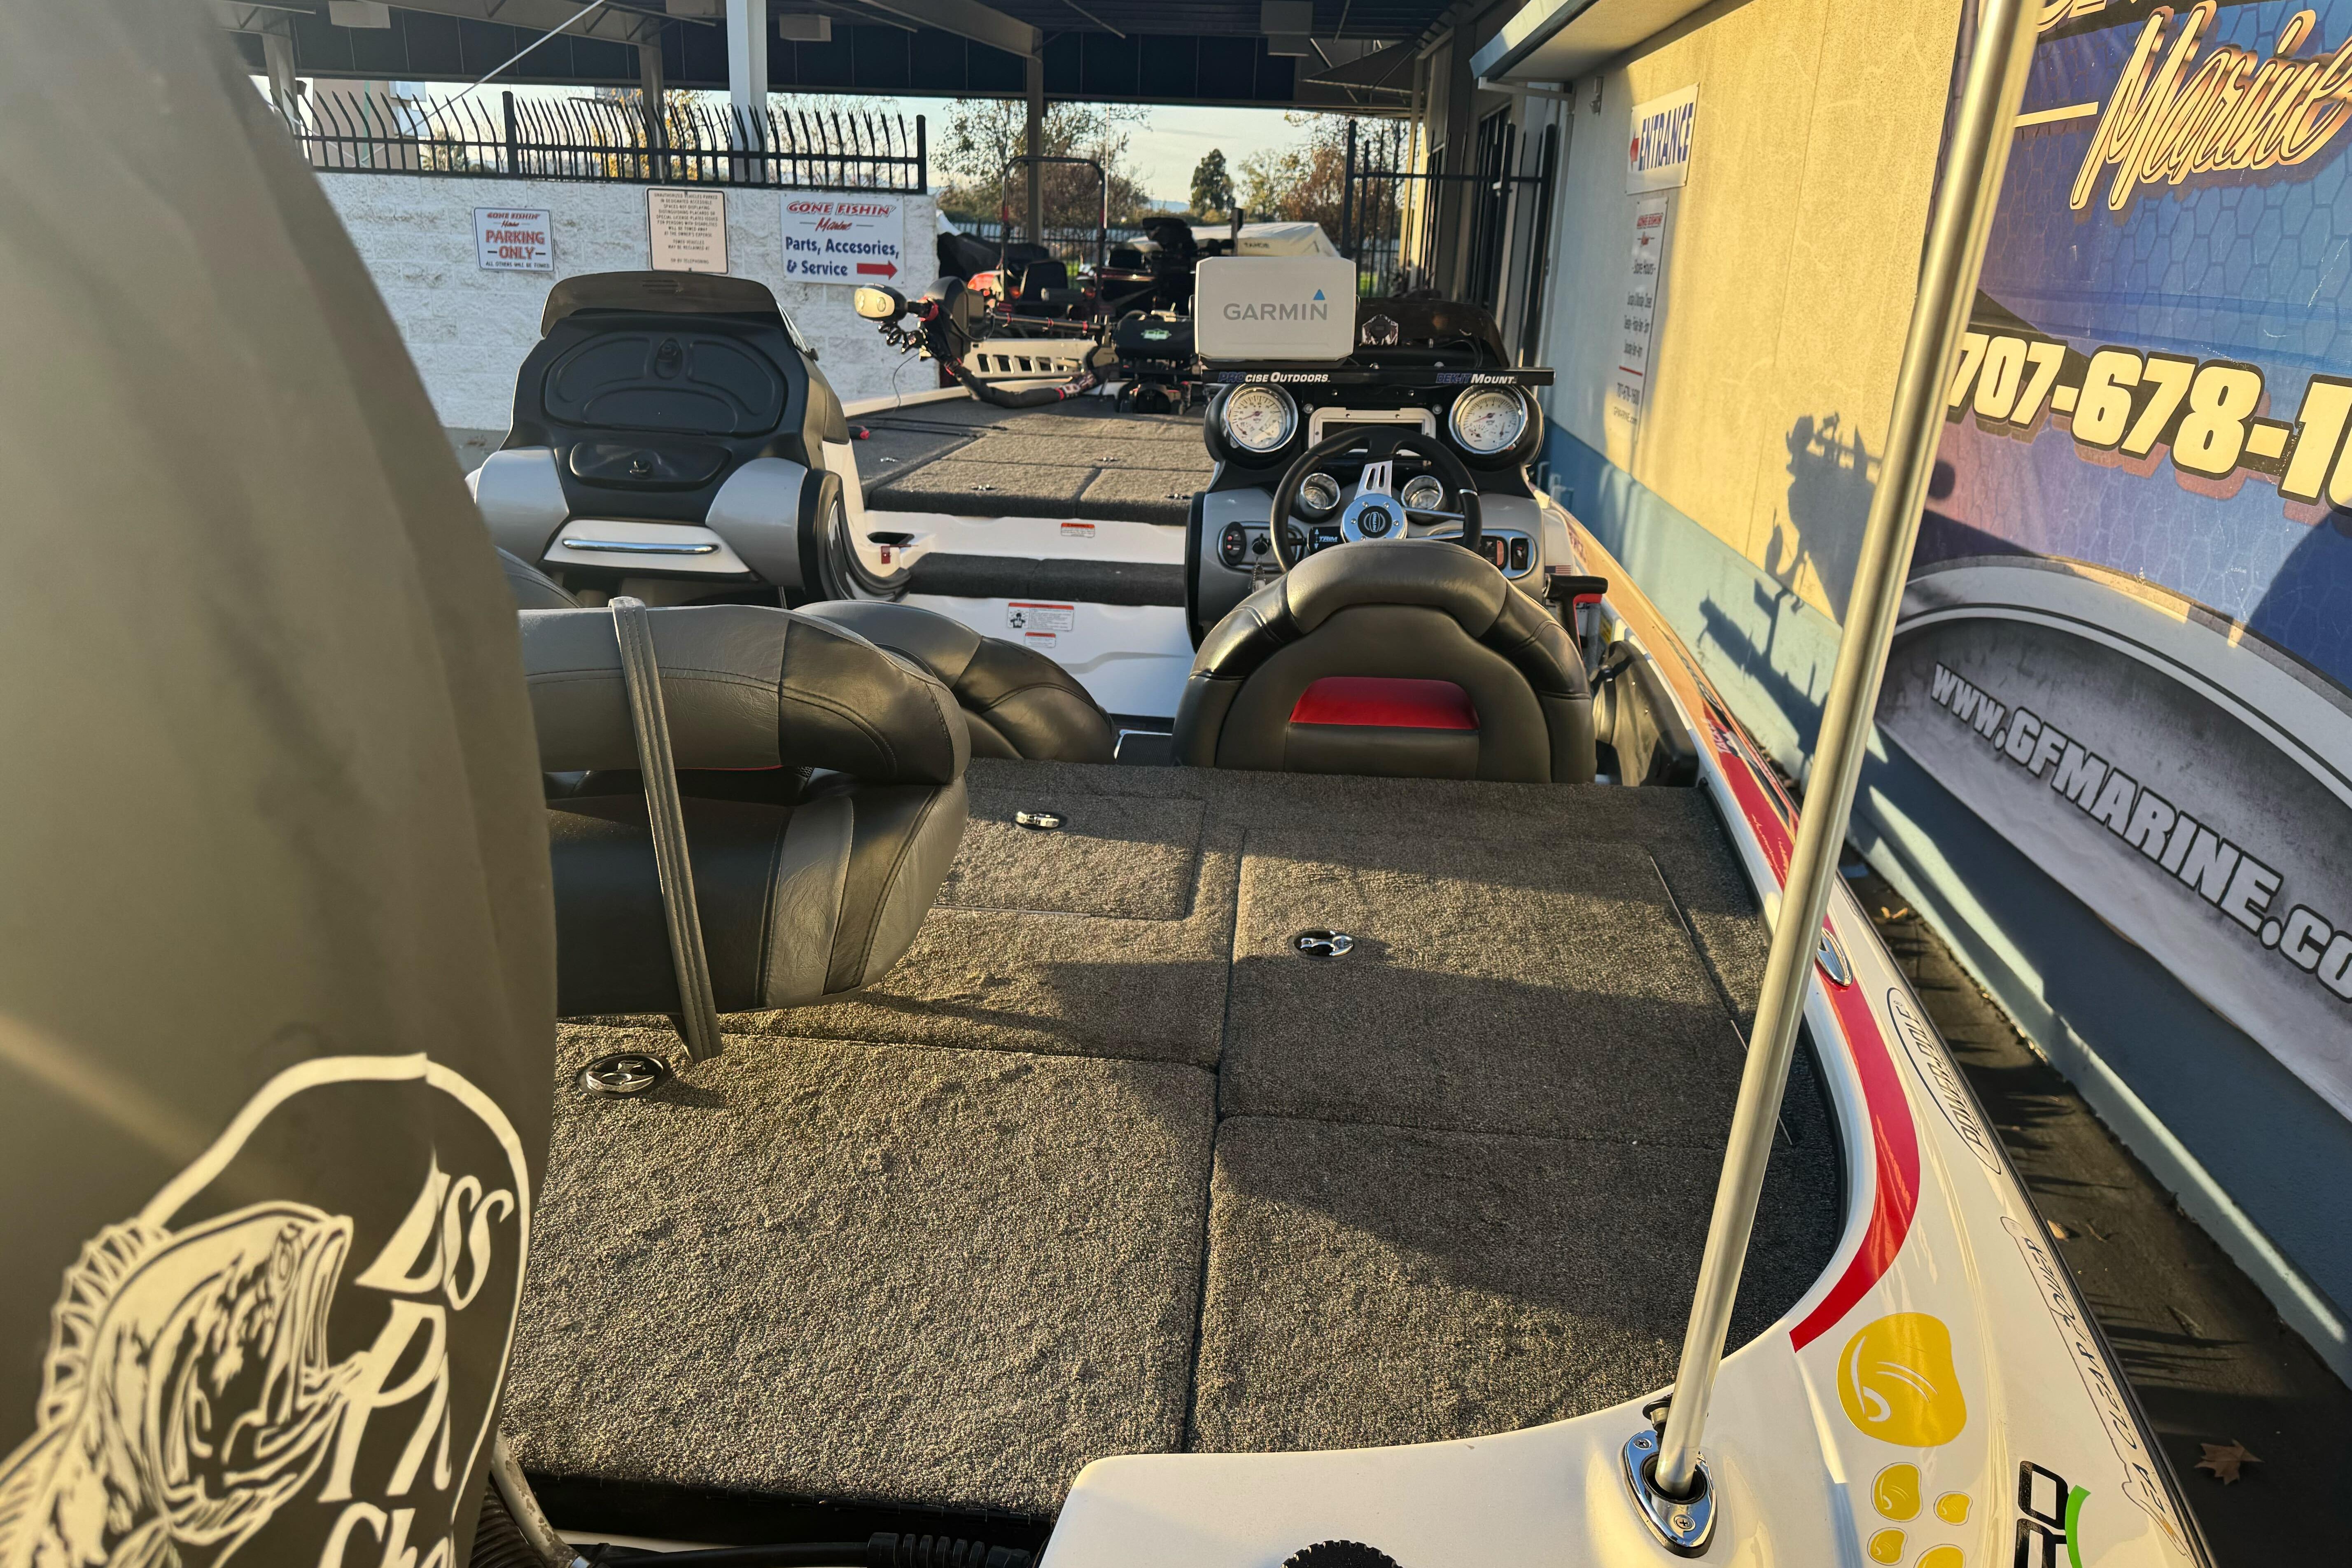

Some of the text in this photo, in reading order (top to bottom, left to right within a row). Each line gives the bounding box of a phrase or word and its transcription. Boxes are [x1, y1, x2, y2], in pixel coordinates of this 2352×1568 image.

[1638, 102, 1694, 171] ENTRANCE
[787, 201, 834, 215] GONE
[485, 230, 545, 245] PARKING
[499, 245, 536, 259] ONLY
[786, 236, 899, 259] Parts, Accesories,
[801, 260, 848, 276] Service
[1223, 303, 1328, 321] GARMIN
[1895, 1006, 1990, 1155] POWER-POLE
[2075, 1341, 2137, 1450] CLEAR
